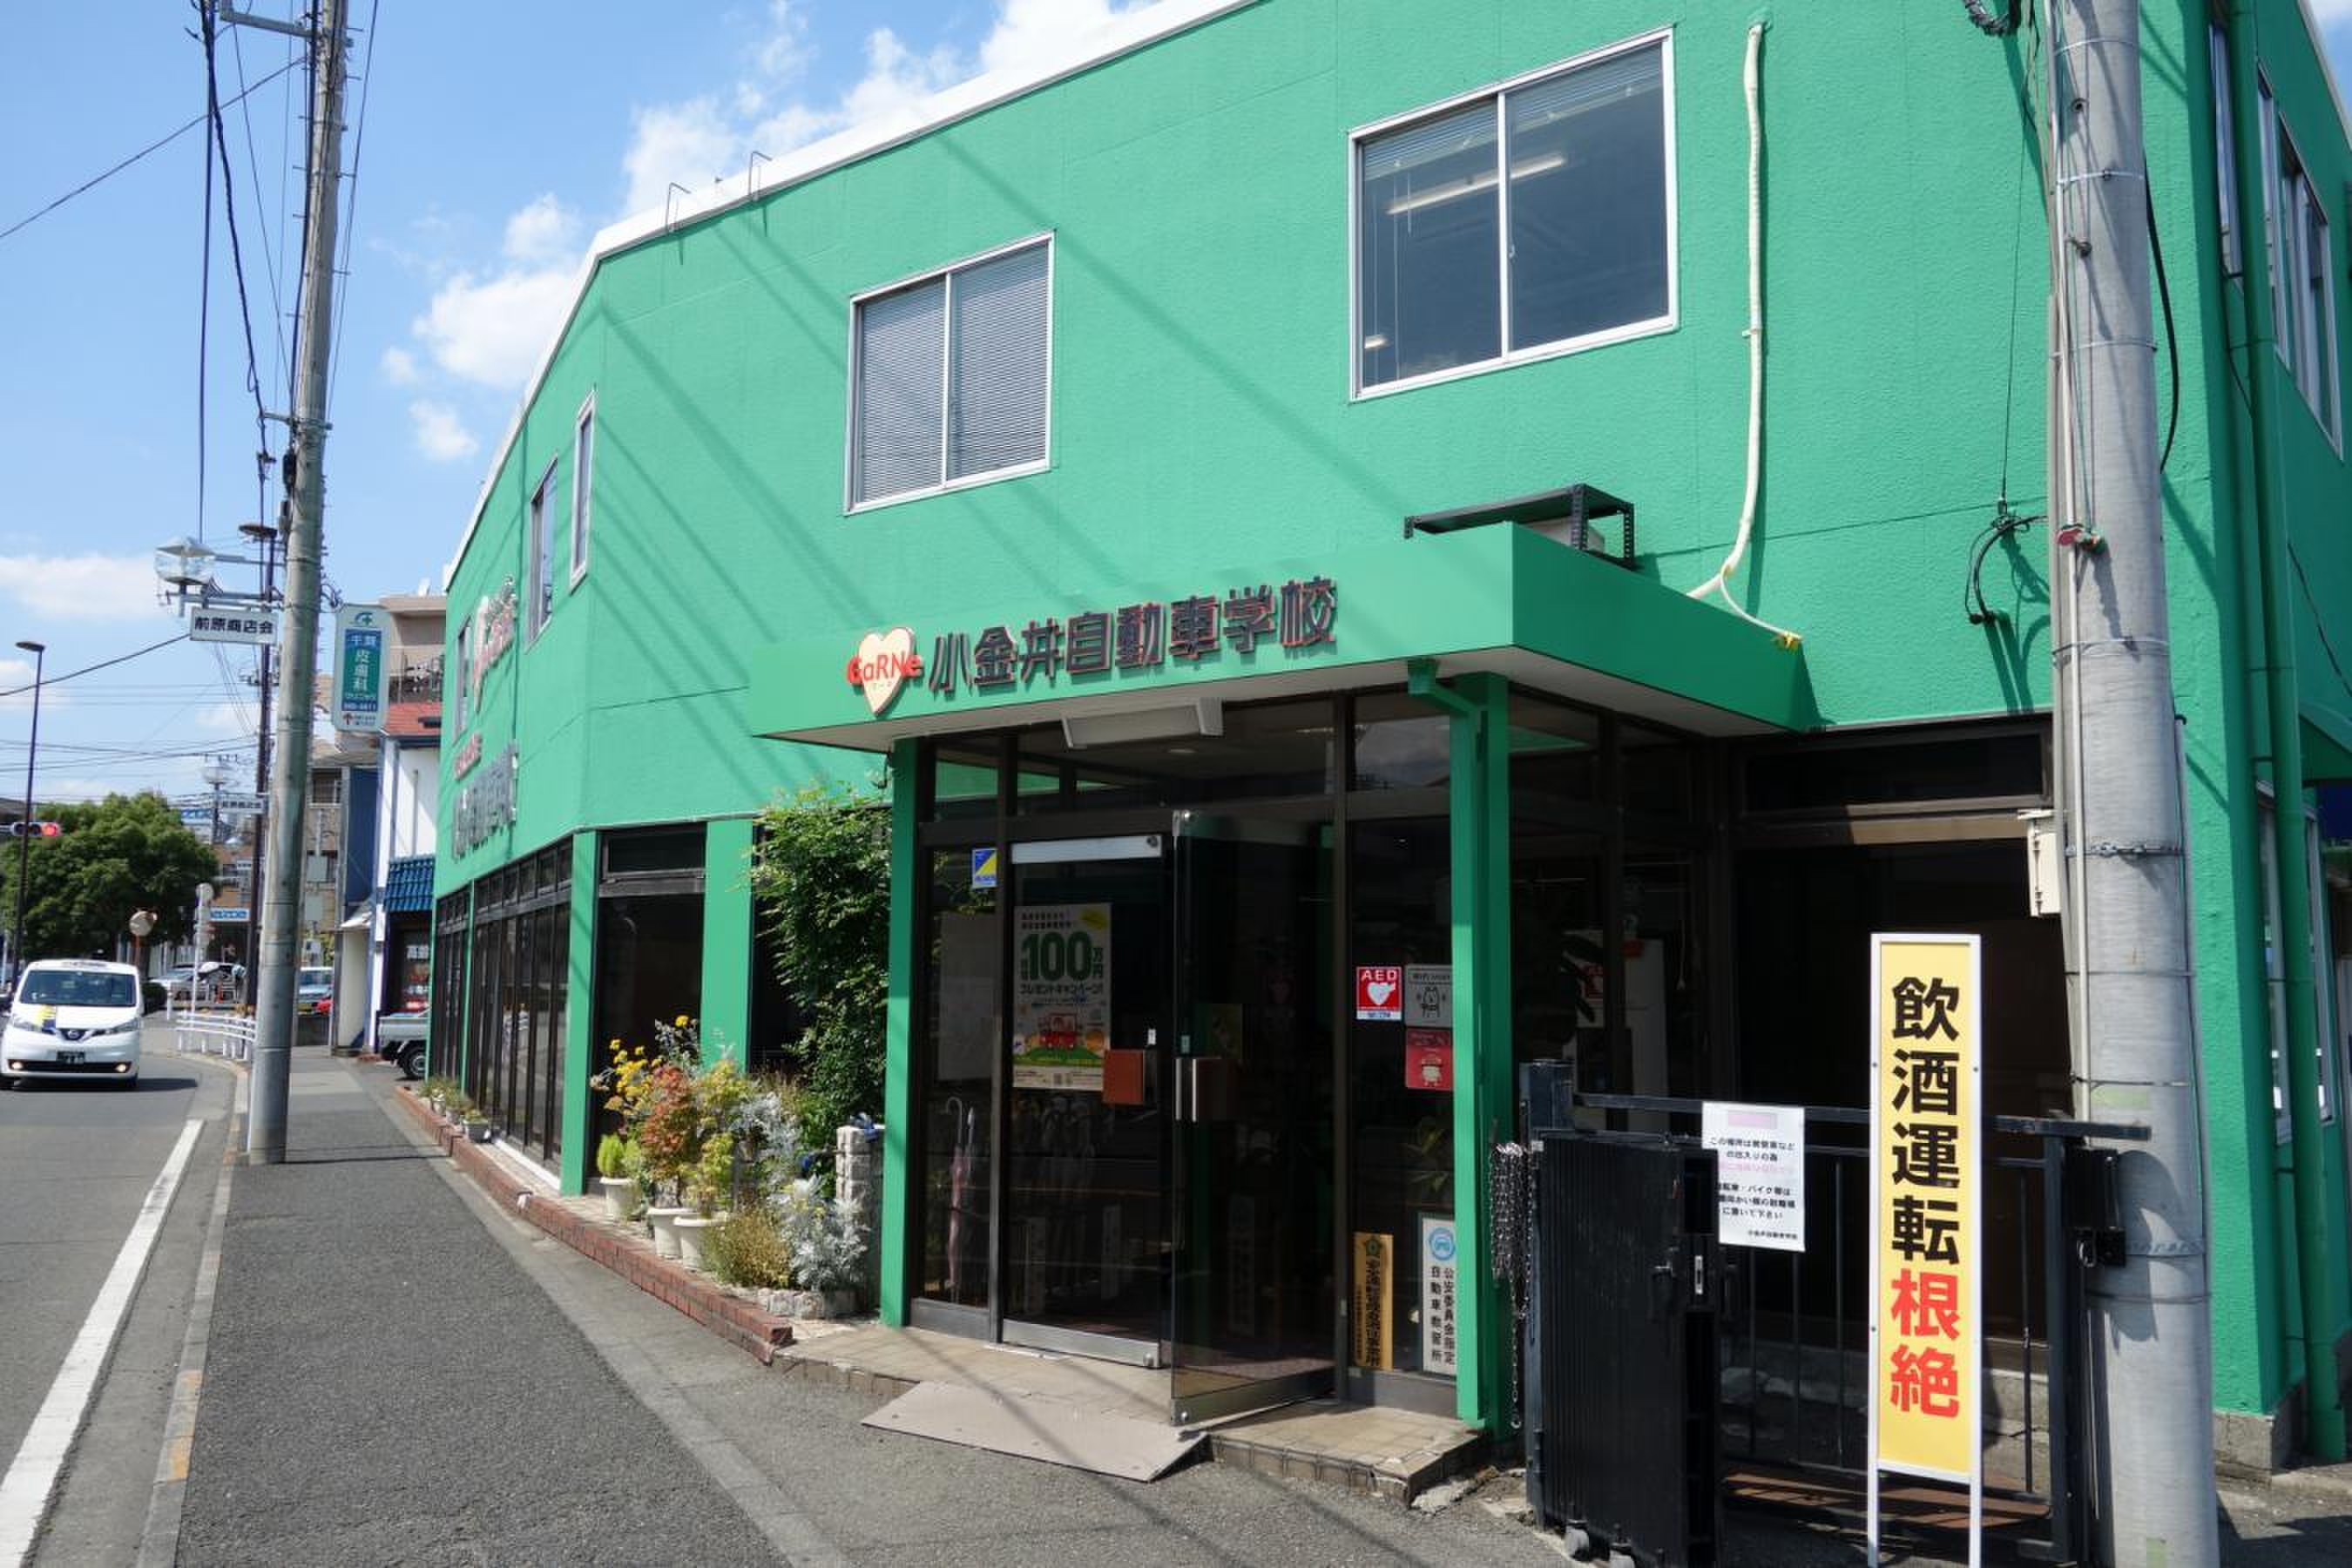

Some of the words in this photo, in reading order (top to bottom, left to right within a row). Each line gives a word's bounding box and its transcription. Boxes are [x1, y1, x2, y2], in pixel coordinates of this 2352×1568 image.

[929, 576, 1336, 693] 小金井自動車学校
[1022, 931, 1092, 981] 100
[1361, 970, 1397, 981] AED
[1889, 976, 1961, 1419] 飲酒運転根絶
